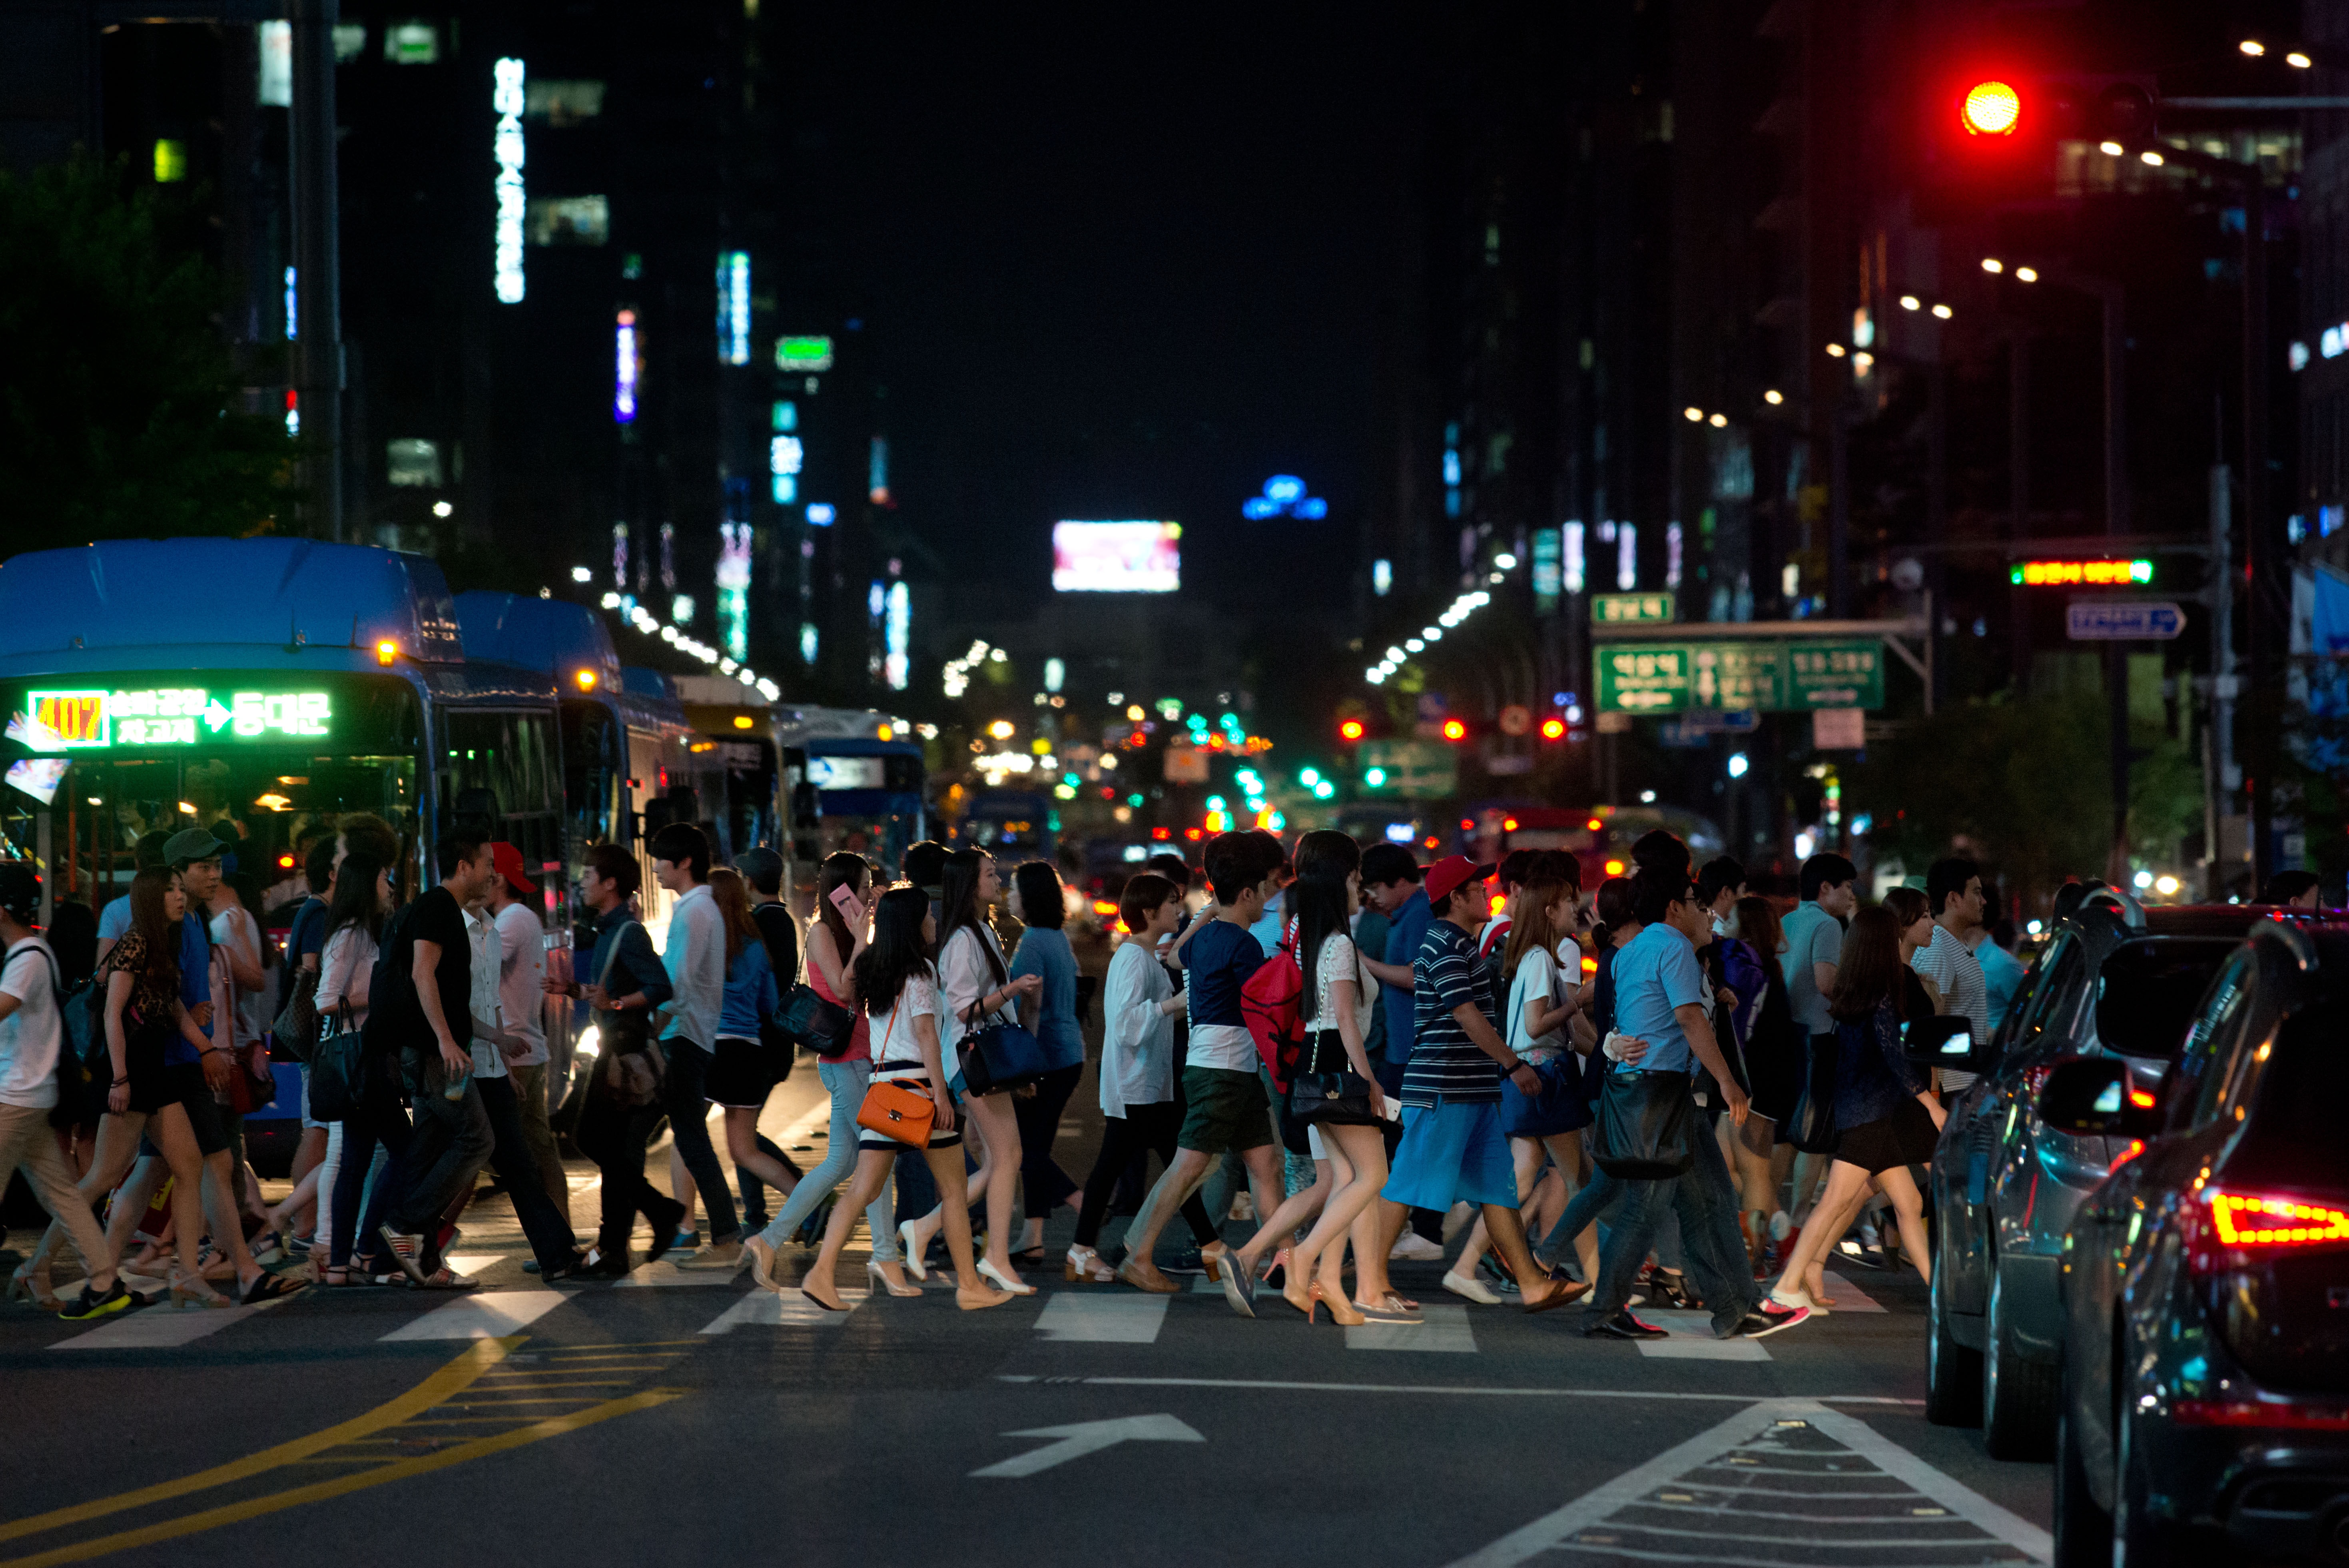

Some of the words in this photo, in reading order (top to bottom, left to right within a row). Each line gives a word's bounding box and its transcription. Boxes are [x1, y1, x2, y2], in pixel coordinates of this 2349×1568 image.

[39, 697, 101, 740] 407
[118, 718, 194, 744] 차고지
[233, 692, 331, 735] 동대문
